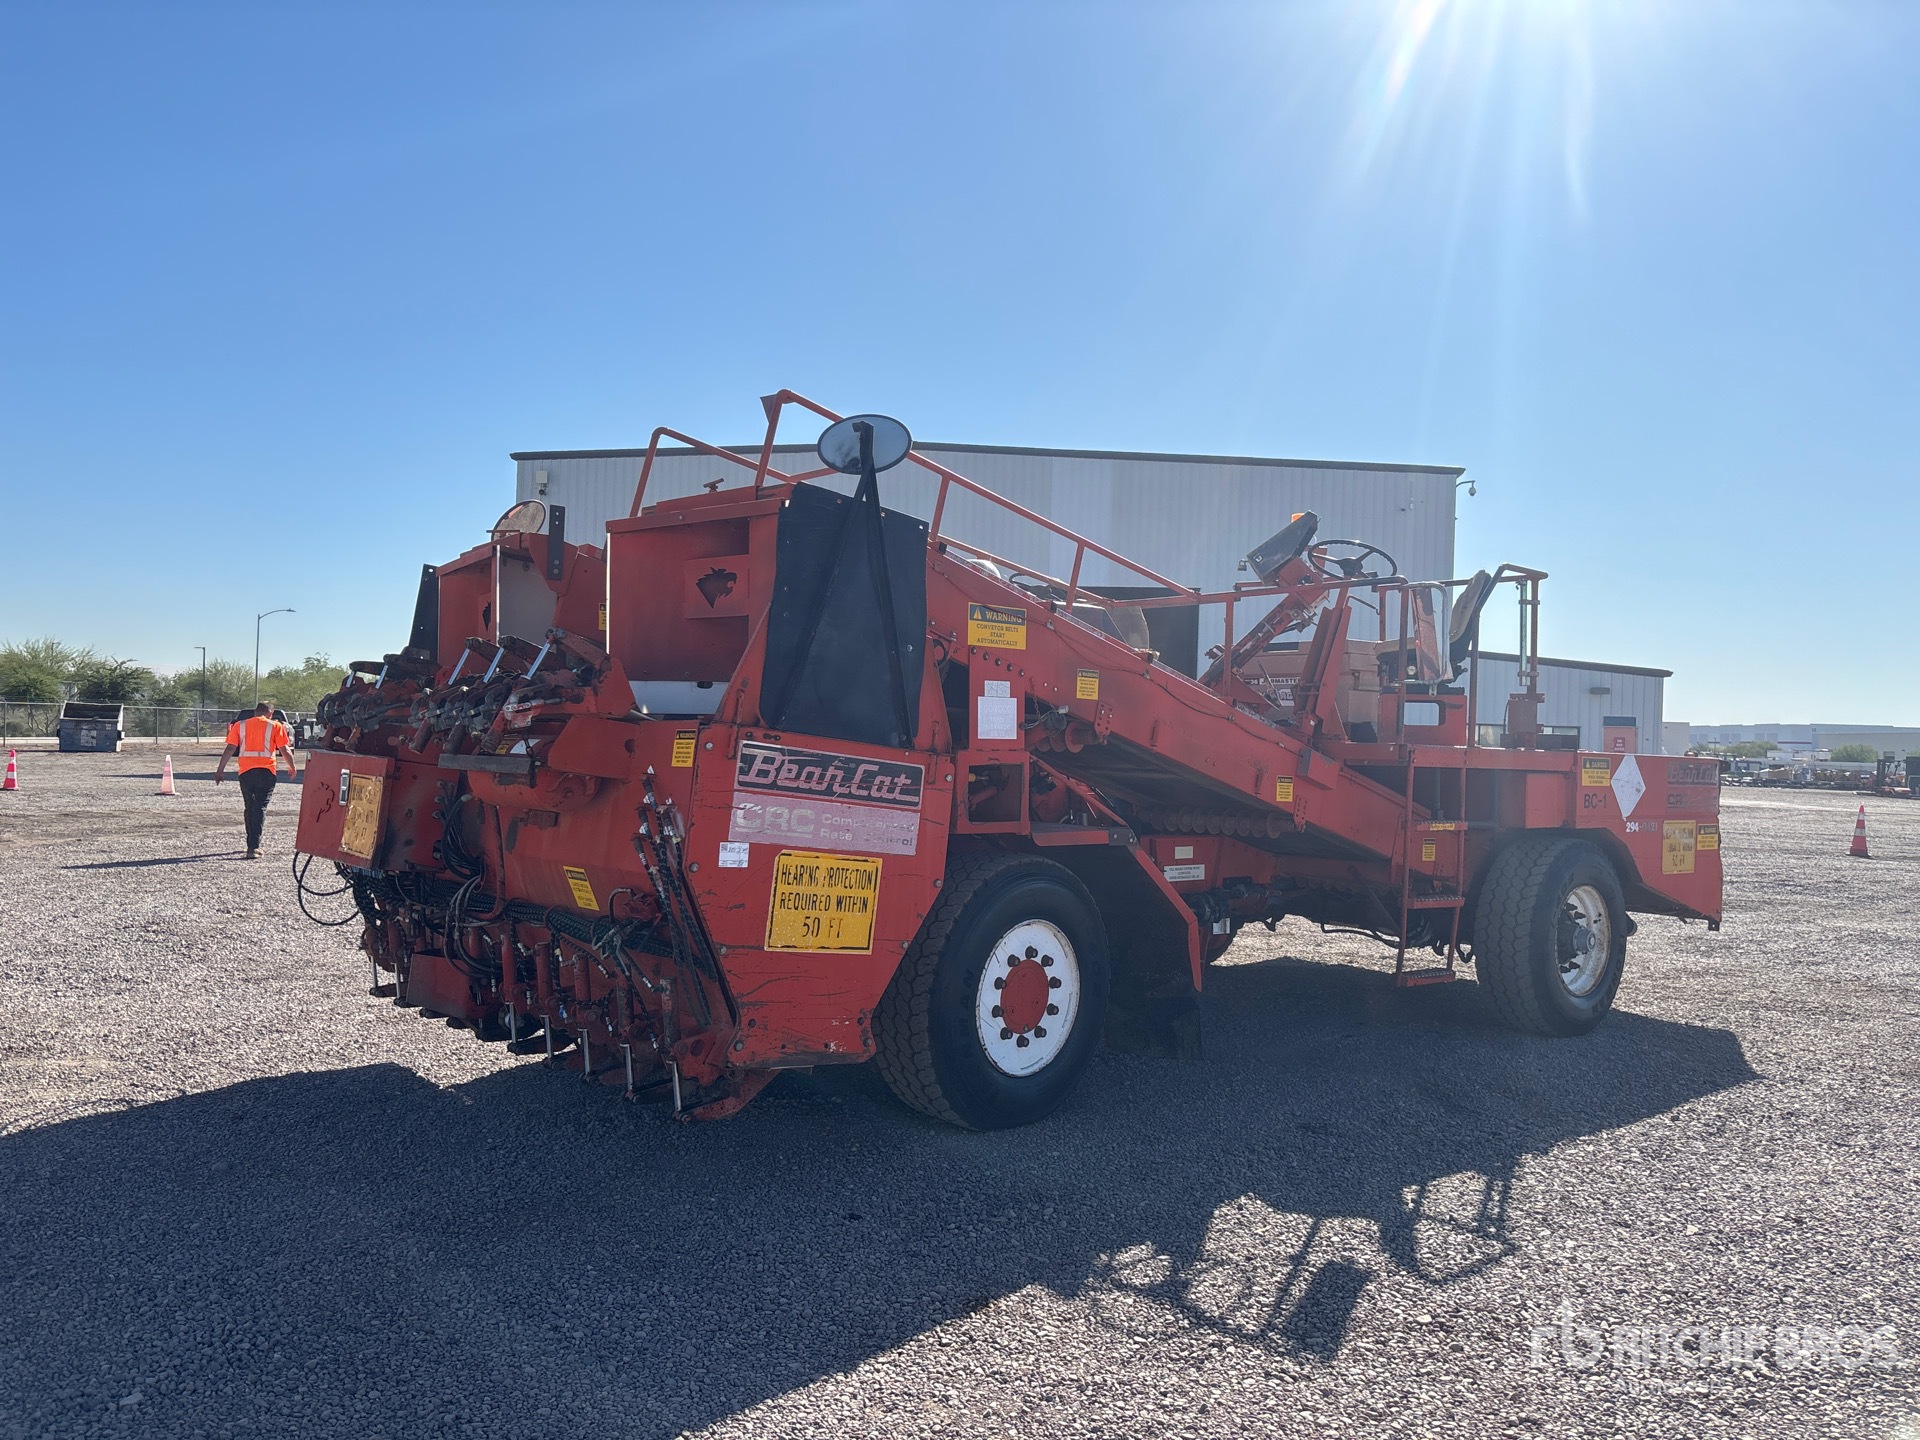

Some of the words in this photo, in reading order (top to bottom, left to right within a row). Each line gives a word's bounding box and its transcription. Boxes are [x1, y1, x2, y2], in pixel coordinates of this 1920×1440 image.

[985, 610, 1023, 623] WARNING
[976, 623, 1005, 632] CONVEYOR
[976, 638, 1018, 647] AUTOMATICALLY
[1583, 793, 1607, 809] BC-1
[820, 828, 853, 841] Rate
[780, 863, 820, 886] HEARING
[779, 892, 830, 912] REQUIRED
[836, 895, 869, 914] WITHIN
[802, 916, 820, 939] 50
[828, 917, 843, 939] FT
